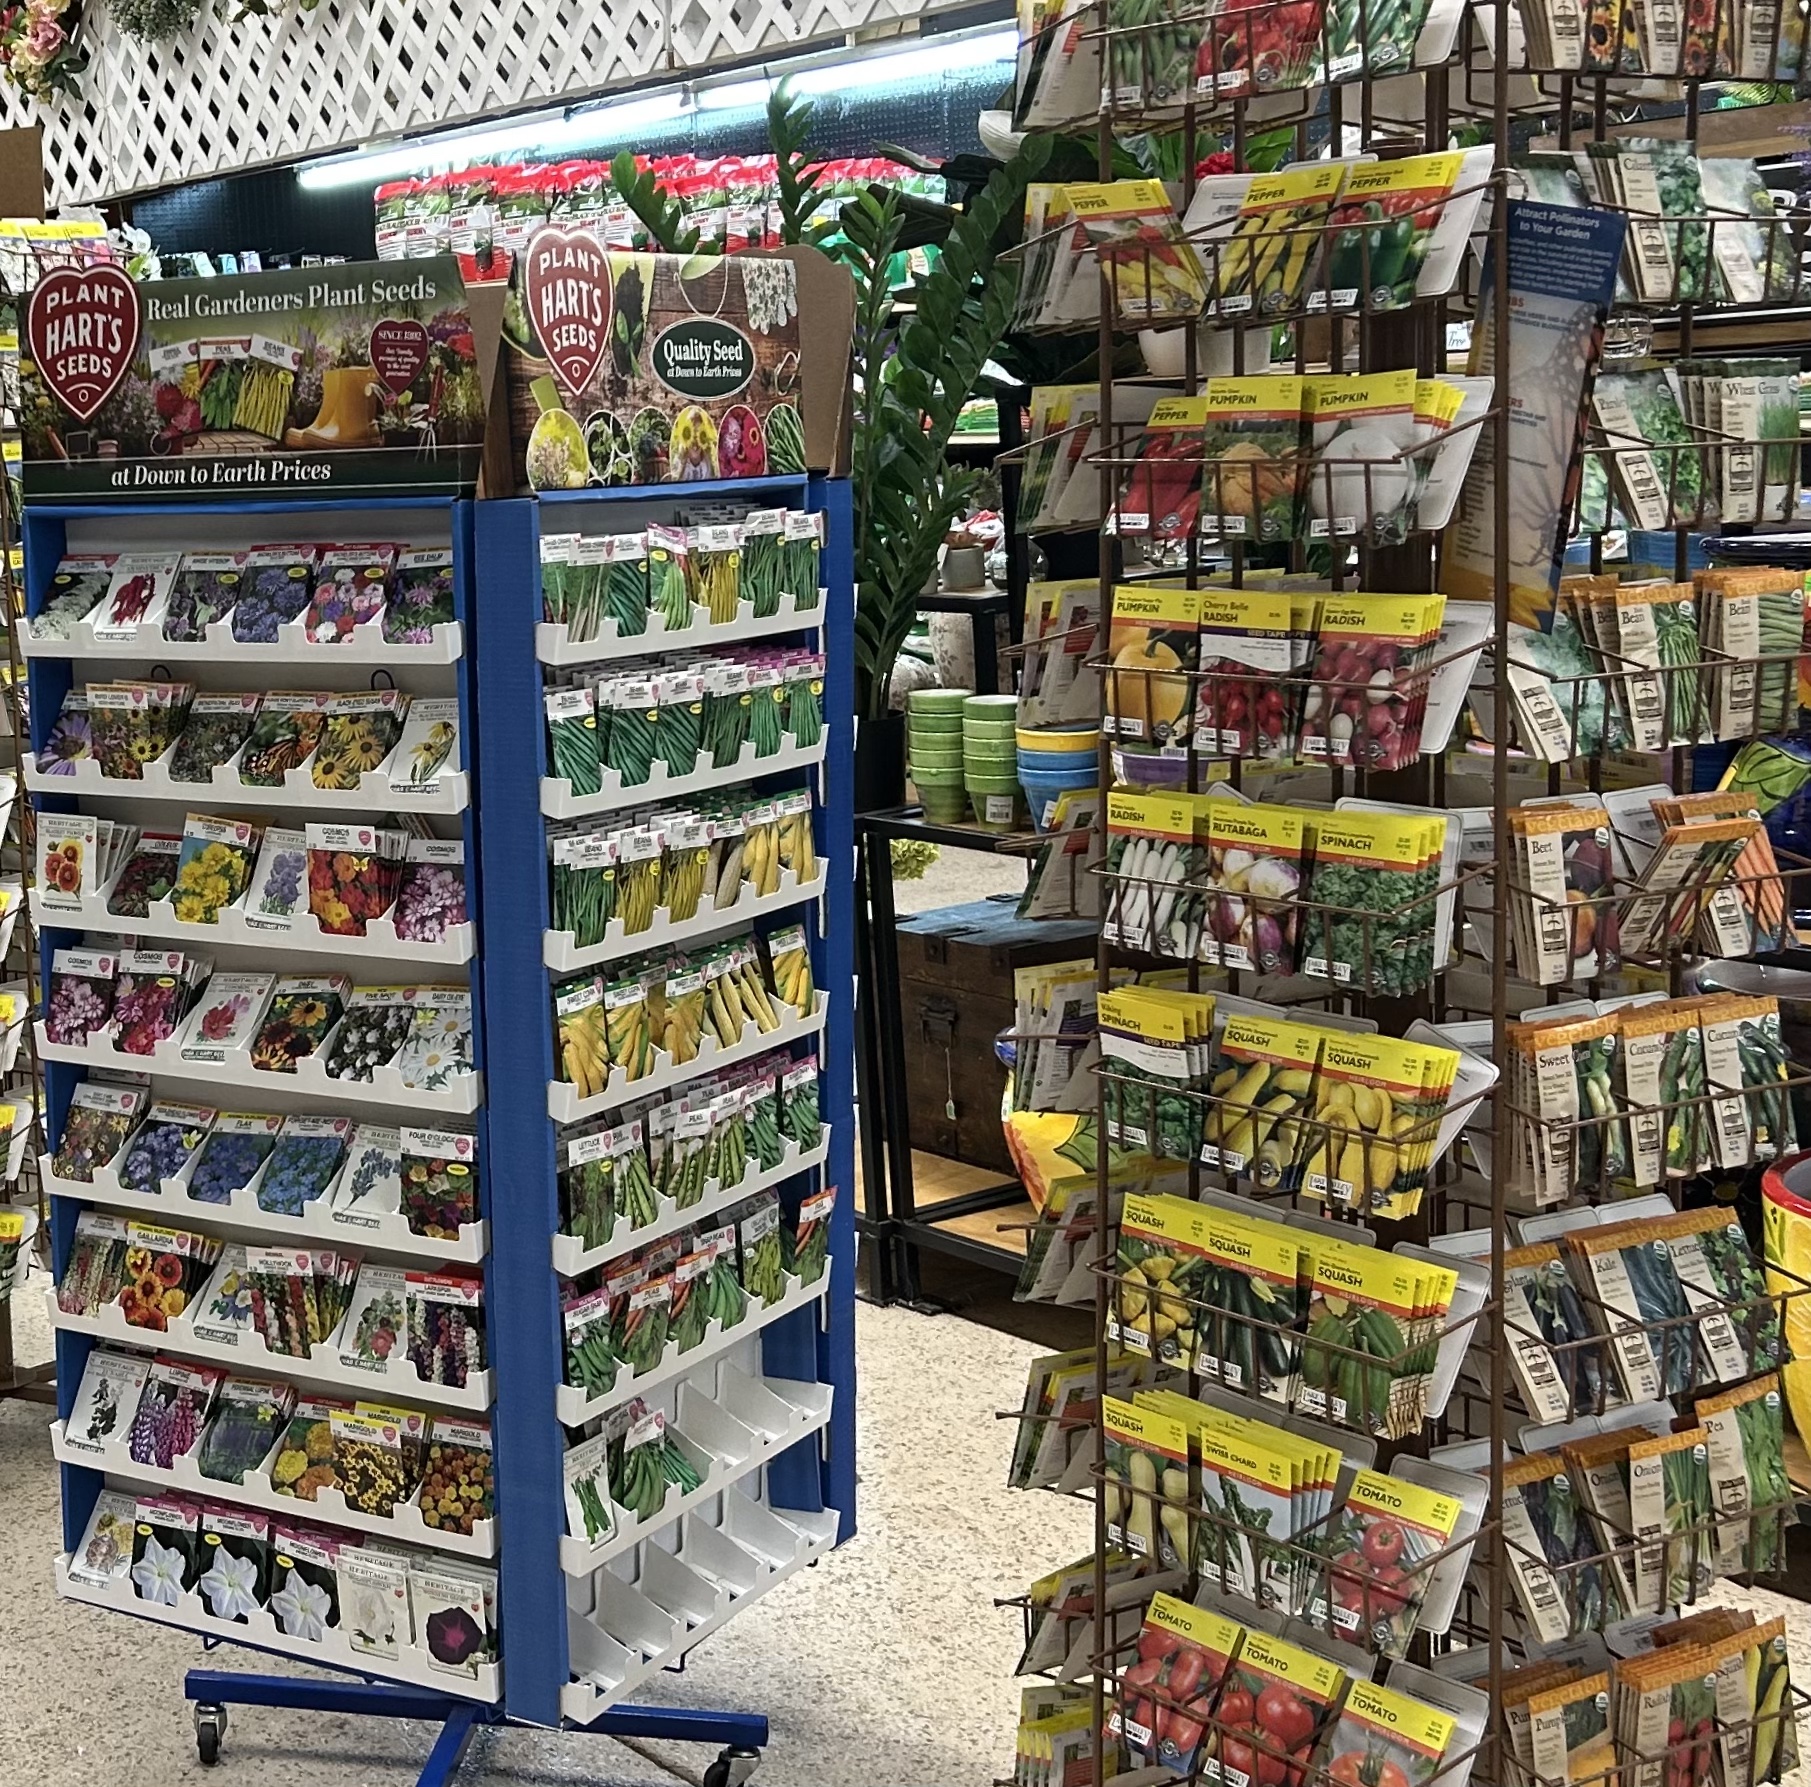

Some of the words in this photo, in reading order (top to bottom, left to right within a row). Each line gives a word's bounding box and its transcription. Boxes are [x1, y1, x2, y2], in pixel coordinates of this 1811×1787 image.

[1350, 176, 1391, 190] PEPPER
[1247, 188, 1286, 203] PEPPER
[1074, 199, 1110, 210] PEPPER
[1515, 206, 1548, 222] Attract
[1549, 211, 1601, 229] Pollinators
[1520, 221, 1531, 232] to
[1533, 222, 1554, 235] Your
[1555, 226, 1591, 241] Garden
[539, 248, 601, 278] PLANT
[46, 283, 125, 314] PLANT
[147, 296, 191, 321] Real
[194, 290, 304, 319] Gardeners
[308, 280, 367, 309] Plant
[371, 274, 437, 304] Seeds
[542, 278, 603, 328] HART'S
[46, 313, 124, 361] HART'S
[553, 323, 597, 352] SEEDS
[663, 339, 711, 366] Quality
[713, 339, 744, 363] Seed
[56, 354, 113, 382] SEEDS
[1209, 394, 1258, 405] PUMPKIN
[1320, 392, 1369, 407] PUMPKIN
[1153, 410, 1189, 421] PEPPER
[112, 470, 131, 487] at
[134, 465, 186, 486] Down
[190, 466, 209, 484] to
[212, 461, 267, 483] Earth
[270, 460, 332, 481] Prices
[1117, 602, 1160, 613] PUMPKIN
[1203, 600, 1228, 612] Cherry
[1230, 602, 1249, 611] Belle
[1729, 603, 1751, 616] Bean
[1203, 612, 1238, 623] RADISH
[1324, 615, 1366, 626] RADISH
[1621, 611, 1646, 625] Bean
[1247, 629, 1266, 638] SEED
[1266, 630, 1286, 638] TAPE
[1110, 810, 1145, 822] RADISH
[1213, 823, 1268, 839] RUTABAGA
[1321, 835, 1372, 851] SPINACH
[1532, 840, 1553, 854] Beet
[67, 956, 93, 966] COSMOS
[133, 951, 163, 961] COSMOS
[1101, 1003, 1121, 1017] Viking
[1101, 1013, 1141, 1031] SPINACH
[1227, 1030, 1271, 1047] SQUASH
[1327, 1052, 1371, 1070] SQUASH
[1539, 1055, 1570, 1069] Sweet
[1572, 1048, 1591, 1063] Corn
[236, 1120, 252, 1128] FLAX
[408, 1131, 426, 1139] FOUR
[578, 1136, 600, 1149] LETTUCE
[1126, 1210, 1165, 1229] SQUASH
[137, 1231, 174, 1246] GAILLARDIA
[1209, 1238, 1251, 1258] SQUASH
[1595, 1257, 1617, 1274] Kale
[1318, 1266, 1363, 1288] SQUASH
[367, 1412, 401, 1424] MARIGOLD
[1106, 1413, 1143, 1434] SQUASH
[343, 1422, 377, 1434] MARIGOLD
[450, 1428, 481, 1439] MARIGOLD
[1206, 1445, 1229, 1462] SWISS
[1231, 1454, 1257, 1470] CHARD
[1634, 1463, 1662, 1477] Onion
[1356, 1485, 1402, 1508] TOMATO
[348, 1565, 390, 1581] HERITAGE
[424, 1580, 466, 1594] HERITAGE
[1152, 1607, 1193, 1632] TOMATO
[1246, 1647, 1289, 1672] TOMATO
[1352, 1696, 1398, 1723] TOMATO
